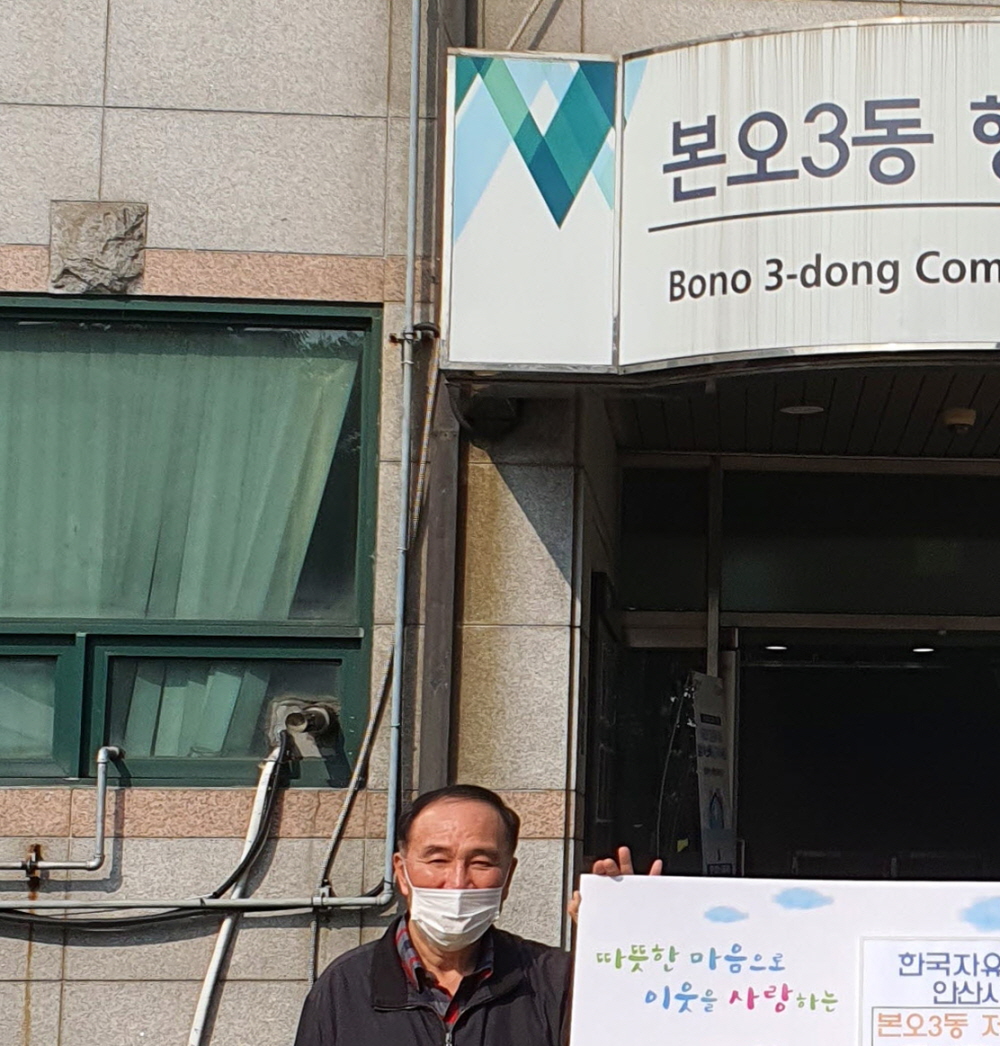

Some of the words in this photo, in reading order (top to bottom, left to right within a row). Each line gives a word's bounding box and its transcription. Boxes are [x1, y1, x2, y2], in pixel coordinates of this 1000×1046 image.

[662, 98, 935, 203] 본오3동
[669, 269, 752, 302] Bono
[764, 253, 900, 295] 3-dong
[597, 945, 679, 972] 따뜻한
[691, 944, 785, 973] 마음으로
[645, 984, 717, 1013] 이웃을
[729, 984, 837, 1012] 사랑하는
[878, 1013, 968, 1039] 본오3동
